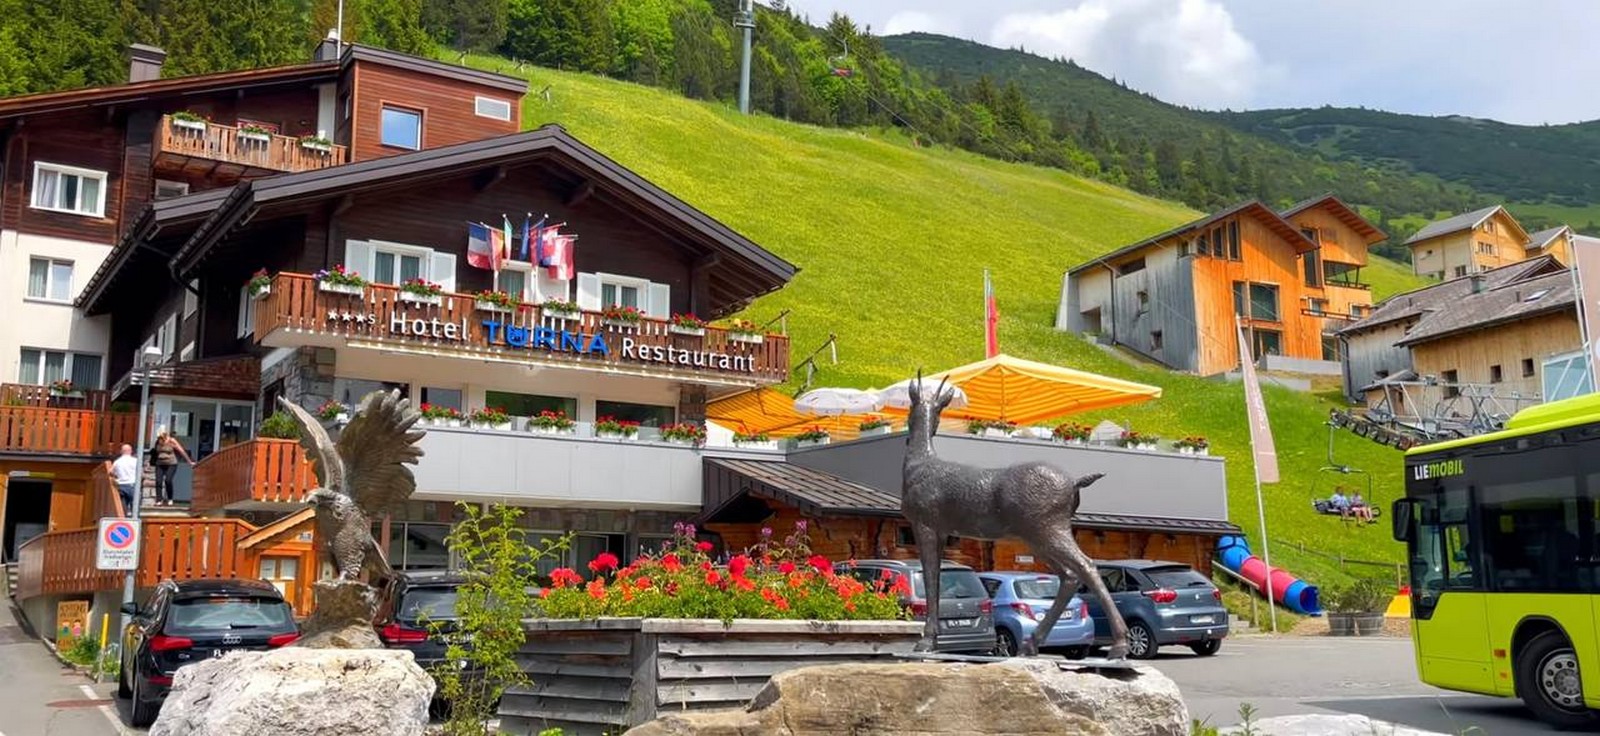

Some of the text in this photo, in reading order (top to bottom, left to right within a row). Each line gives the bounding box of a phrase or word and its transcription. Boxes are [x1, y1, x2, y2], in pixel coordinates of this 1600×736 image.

[390, 310, 468, 341] Hotel
[482, 320, 610, 356] TURNA
[622, 337, 755, 372] Restaurant
